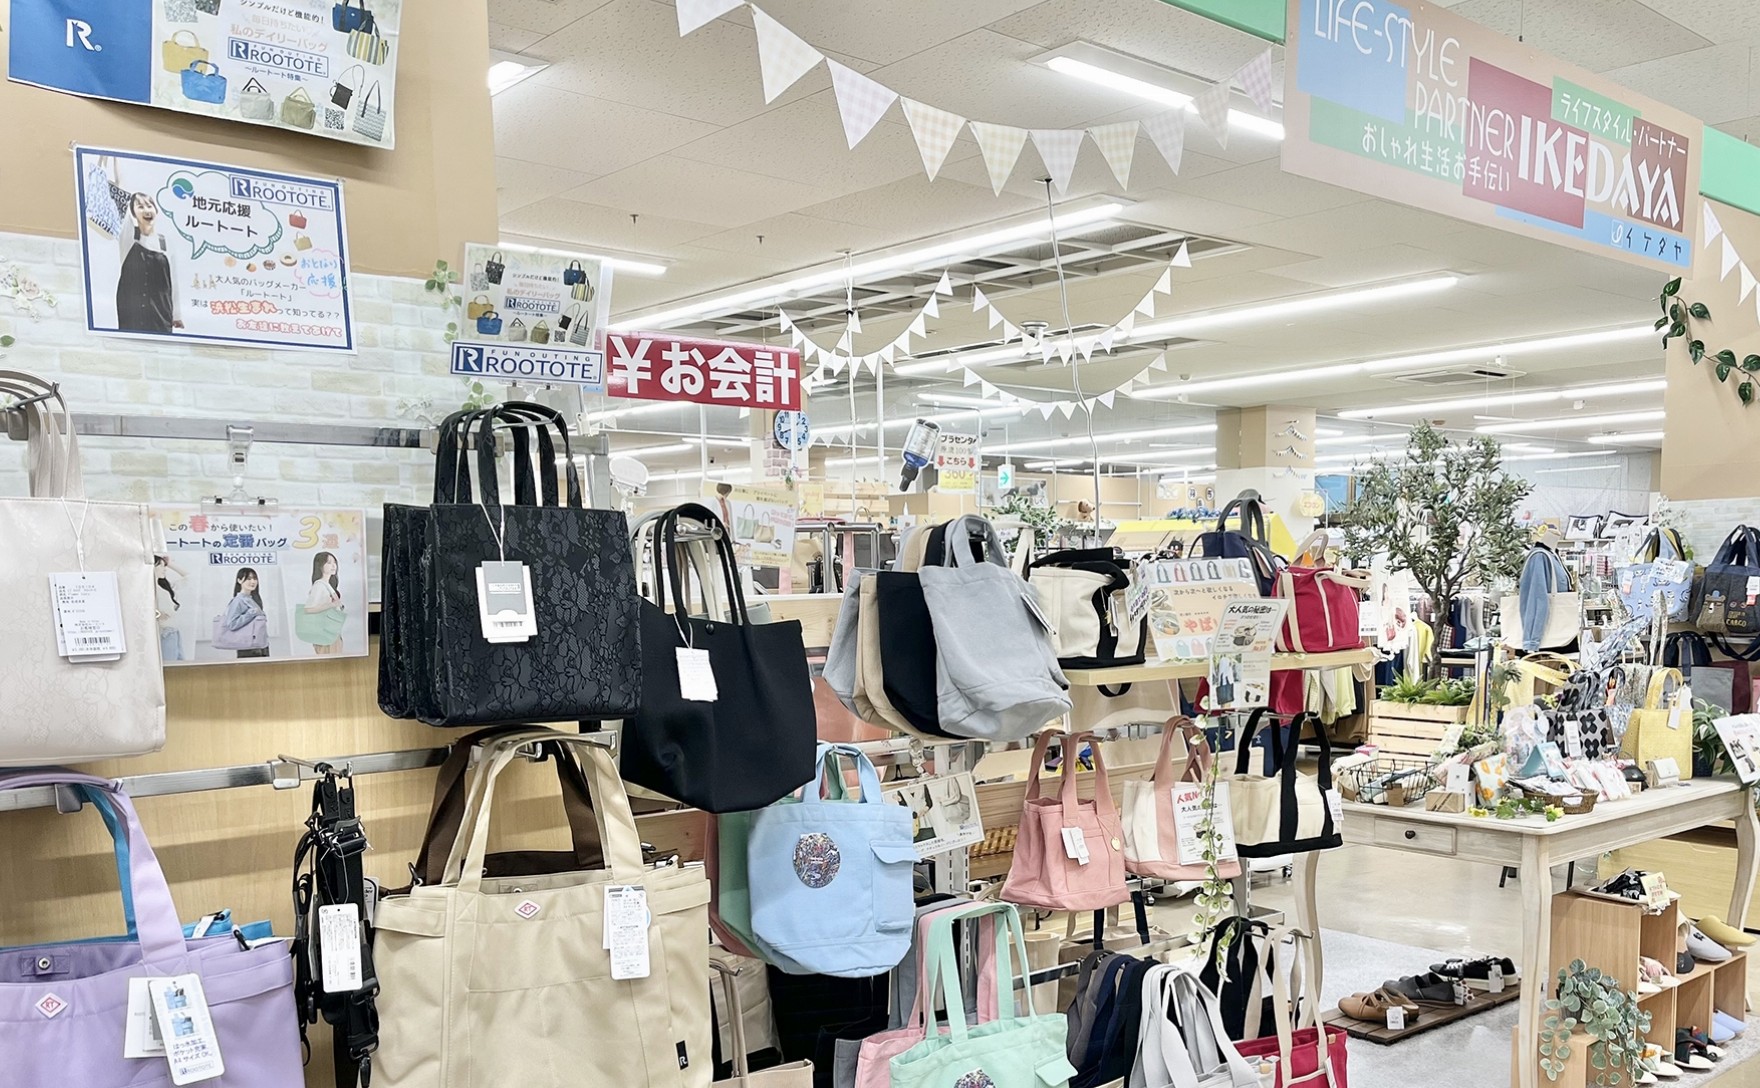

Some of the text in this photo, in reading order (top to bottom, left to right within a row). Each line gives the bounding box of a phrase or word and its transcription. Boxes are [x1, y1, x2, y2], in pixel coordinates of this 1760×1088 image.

[1314, 0, 1460, 87] LIFE-STYLE
[250, 49, 323, 74] ROOTOTE
[1414, 80, 1515, 160] PARTNER
[1560, 93, 1686, 158] ライフスタイル・パートナー
[1362, 122, 1510, 192] おしゃれ生活お手伝い
[1518, 114, 1680, 228] IKEDAYA
[192, 195, 252, 219] 地元応援
[253, 186, 328, 207] ROOTOTE
[185, 215, 258, 238] ルートート
[215, 275, 306, 291] 大人気のバッグメーカー
[491, 349, 591, 362] FUN OUTING
[486, 356, 593, 379] ROOTOTE
[946, 457, 967, 466] こちら
[169, 514, 273, 533] この春から使いたい！
[223, 555, 274, 564] ROOTOTE
